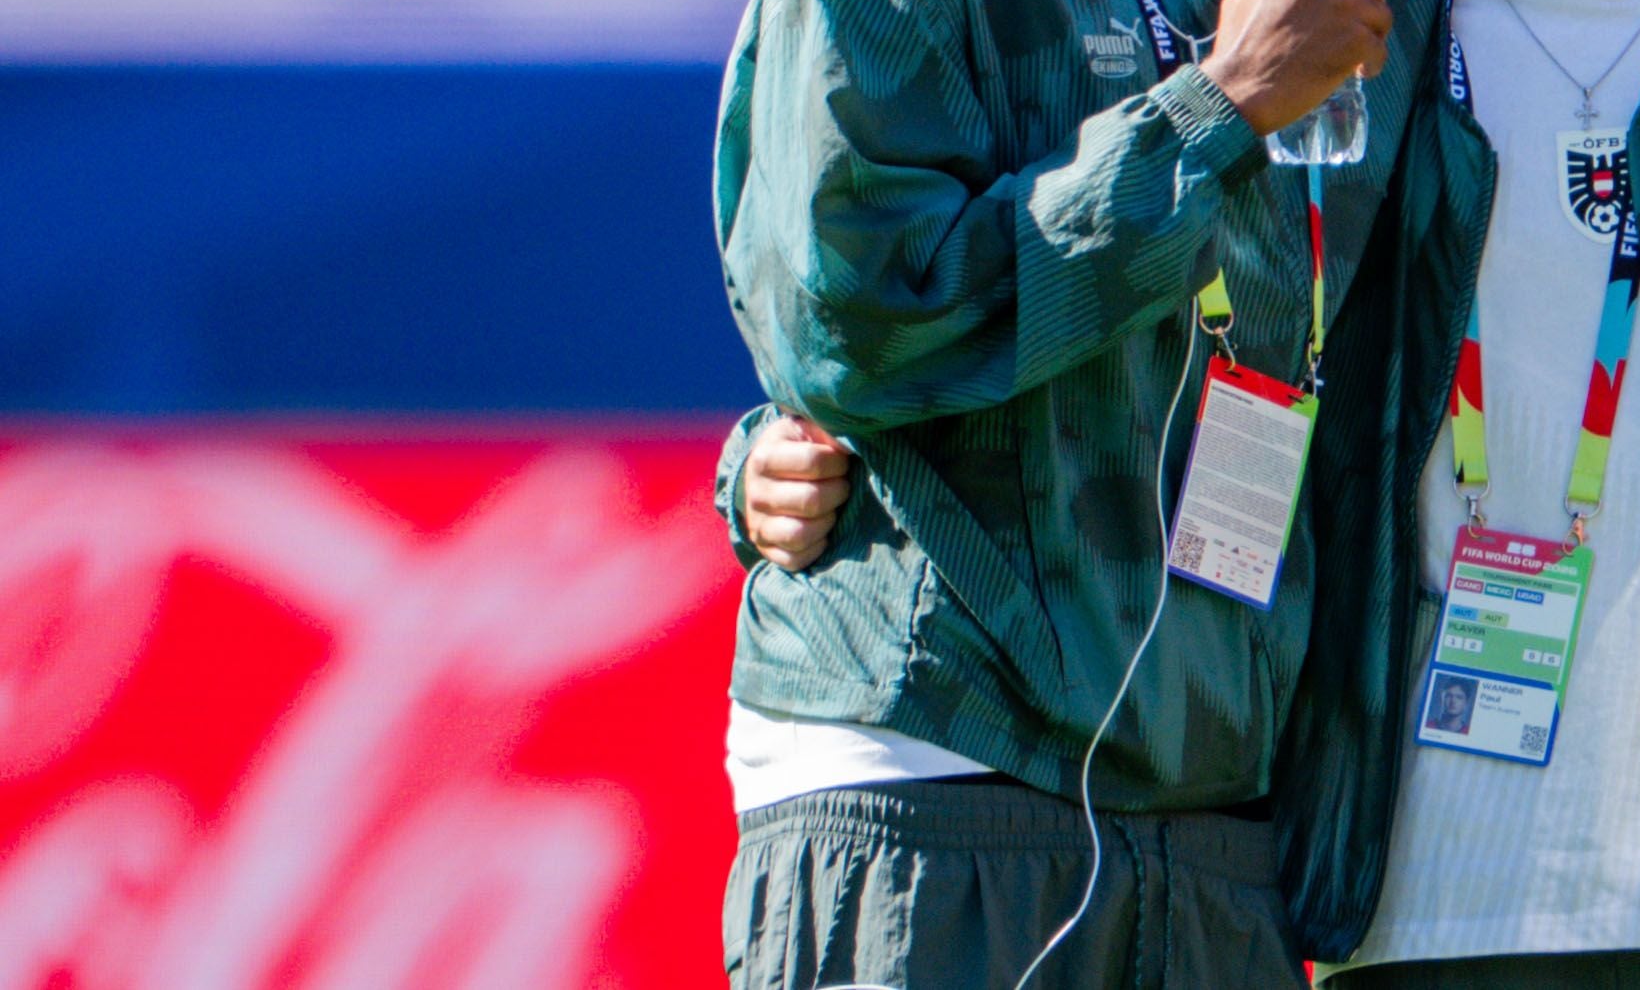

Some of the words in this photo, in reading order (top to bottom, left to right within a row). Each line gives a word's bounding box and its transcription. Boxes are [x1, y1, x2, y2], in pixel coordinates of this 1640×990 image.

[1083, 34, 1136, 55] PUMA
[1150, 13, 1176, 60] FIFA
[1449, 31, 1466, 101] ORLD
[1461, 547, 1484, 559] FIFA
[1484, 551, 1521, 566] WORLD
[1521, 558, 1543, 569] CUP
[0, 438, 755, 990] ola
